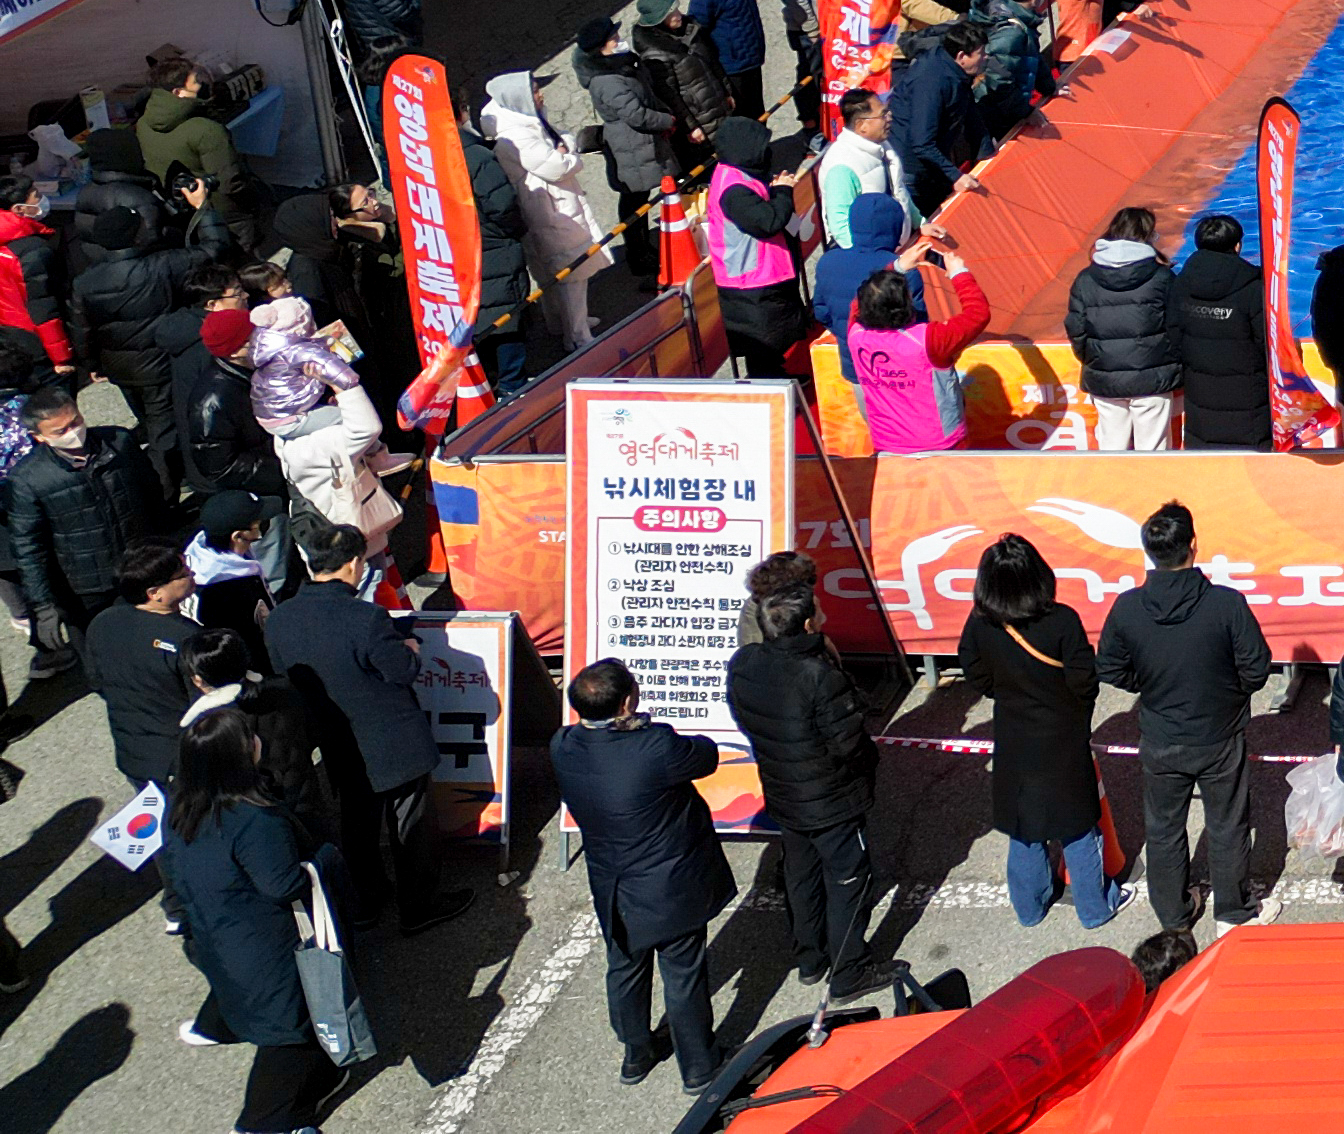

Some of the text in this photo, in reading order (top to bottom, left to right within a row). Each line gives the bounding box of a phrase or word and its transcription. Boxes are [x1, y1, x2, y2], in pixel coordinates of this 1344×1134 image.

[392, 73, 424, 101] 제27회
[392, 94, 464, 338] 영덕대게축제
[618, 426, 741, 467] 영덕대게축제
[603, 477, 756, 503] 낚시체험장 내
[642, 509, 721, 530] 주의사항
[623, 542, 672, 556] 낚시대를
[675, 542, 700, 556] 인한
[702, 543, 752, 557] 상해조심
[634, 559, 734, 574] (관리자 안전수칙)
[623, 579, 648, 592] 낙상
[651, 579, 675, 593] 조심
[621, 596, 663, 610] (관리자
[666, 597, 715, 611] 안전수칙
[623, 616, 648, 629] 음주
[651, 616, 688, 630] 과다자
[690, 617, 715, 631] 입장
[678, 635, 705, 648] 소란자
[669, 675, 689, 686] 인해
[691, 675, 721, 687] 발생한
[648, 706, 709, 719] 알려드립니다
